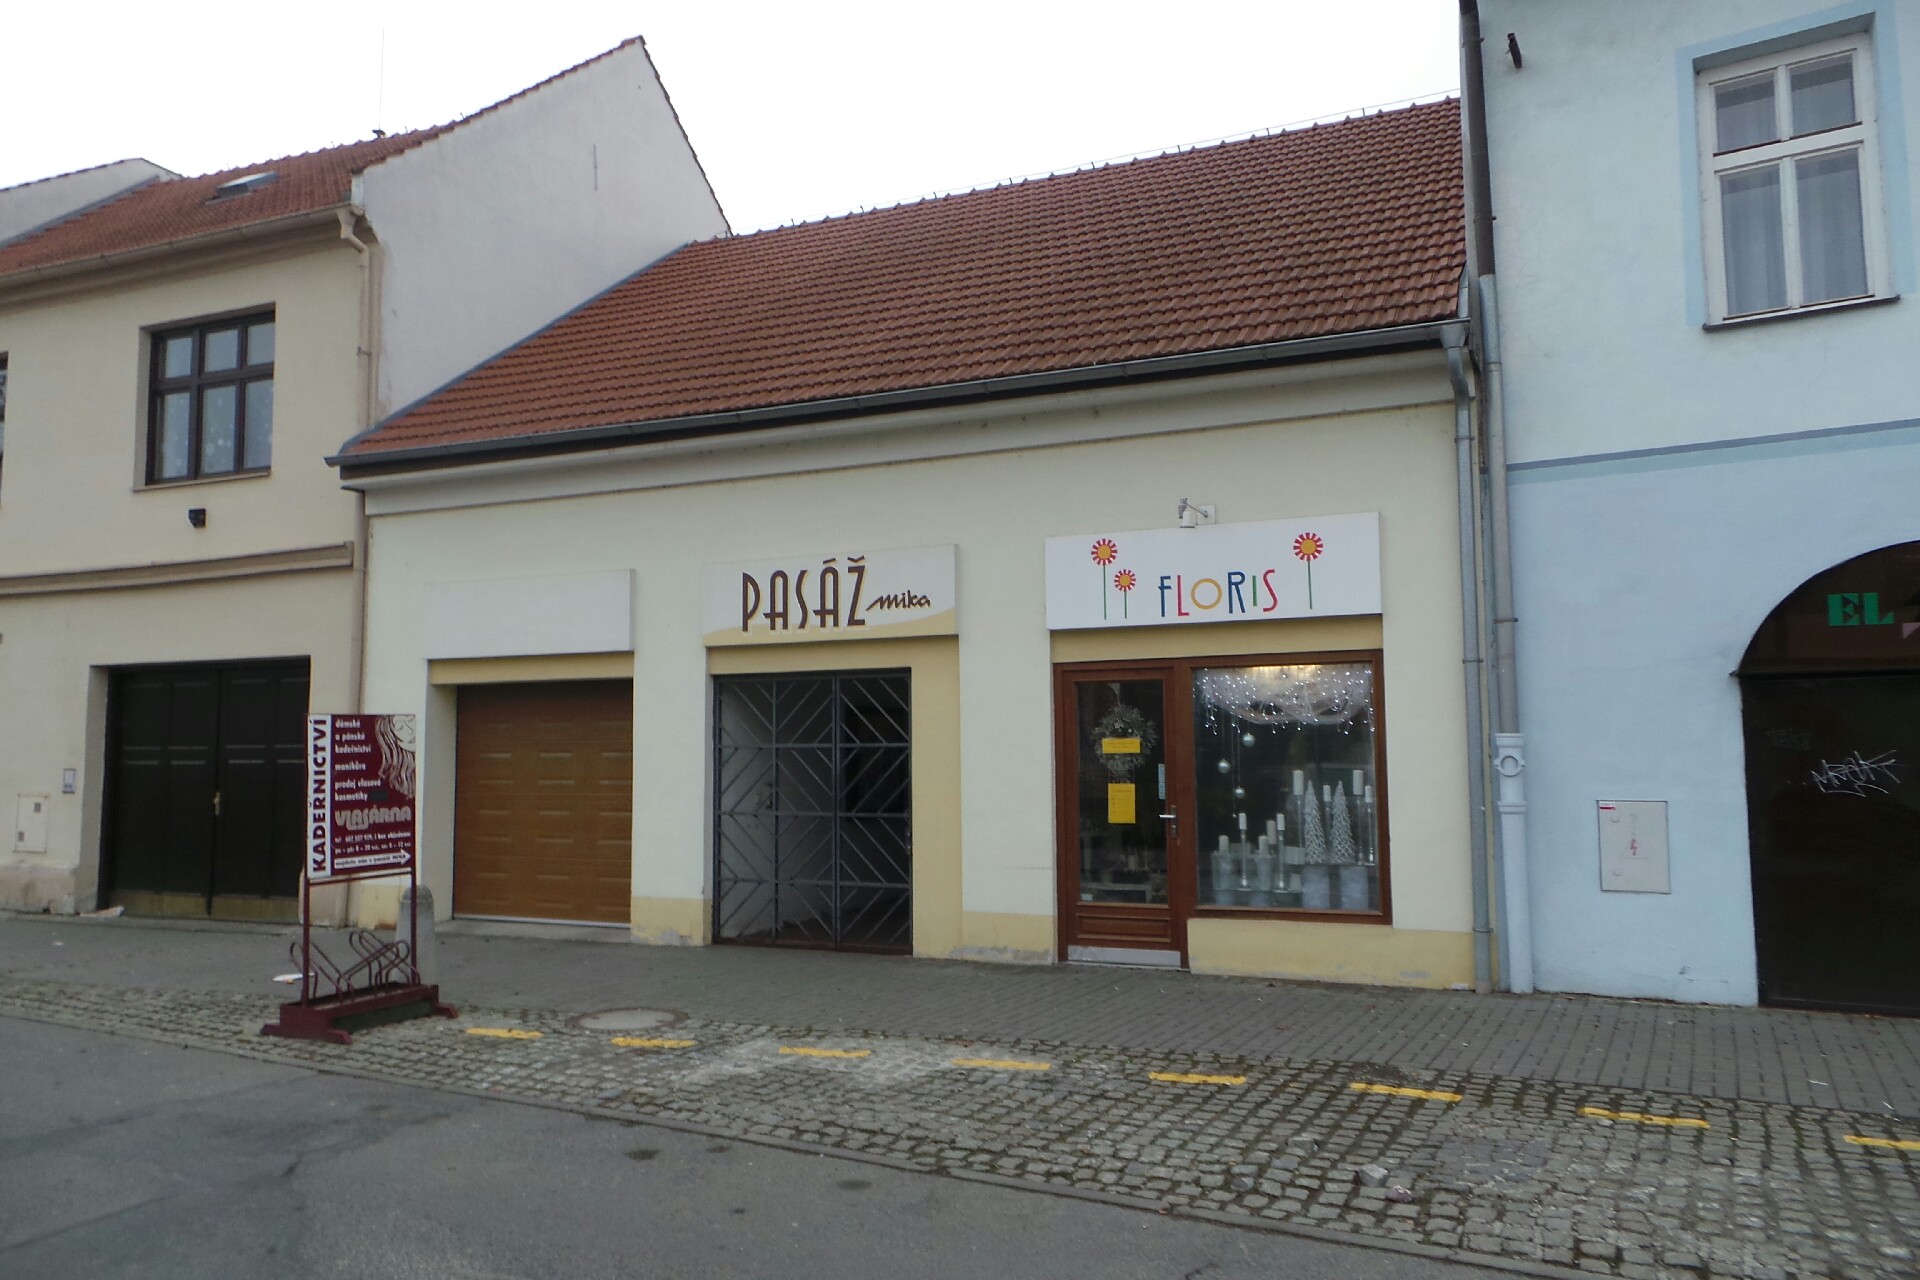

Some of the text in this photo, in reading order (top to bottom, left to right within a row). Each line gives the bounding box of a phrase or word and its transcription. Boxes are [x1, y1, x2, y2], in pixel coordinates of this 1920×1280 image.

[742, 555, 931, 633] PASÁŽ mika
[1158, 568, 1279, 618] FLORIS
[1826, 592, 1894, 627] EL
[309, 719, 327, 873] KADEŘNICTVÍ
[335, 778, 356, 791] prodej
[335, 790, 368, 802] kosmetiky
[334, 804, 412, 831] VLASÁRNA
